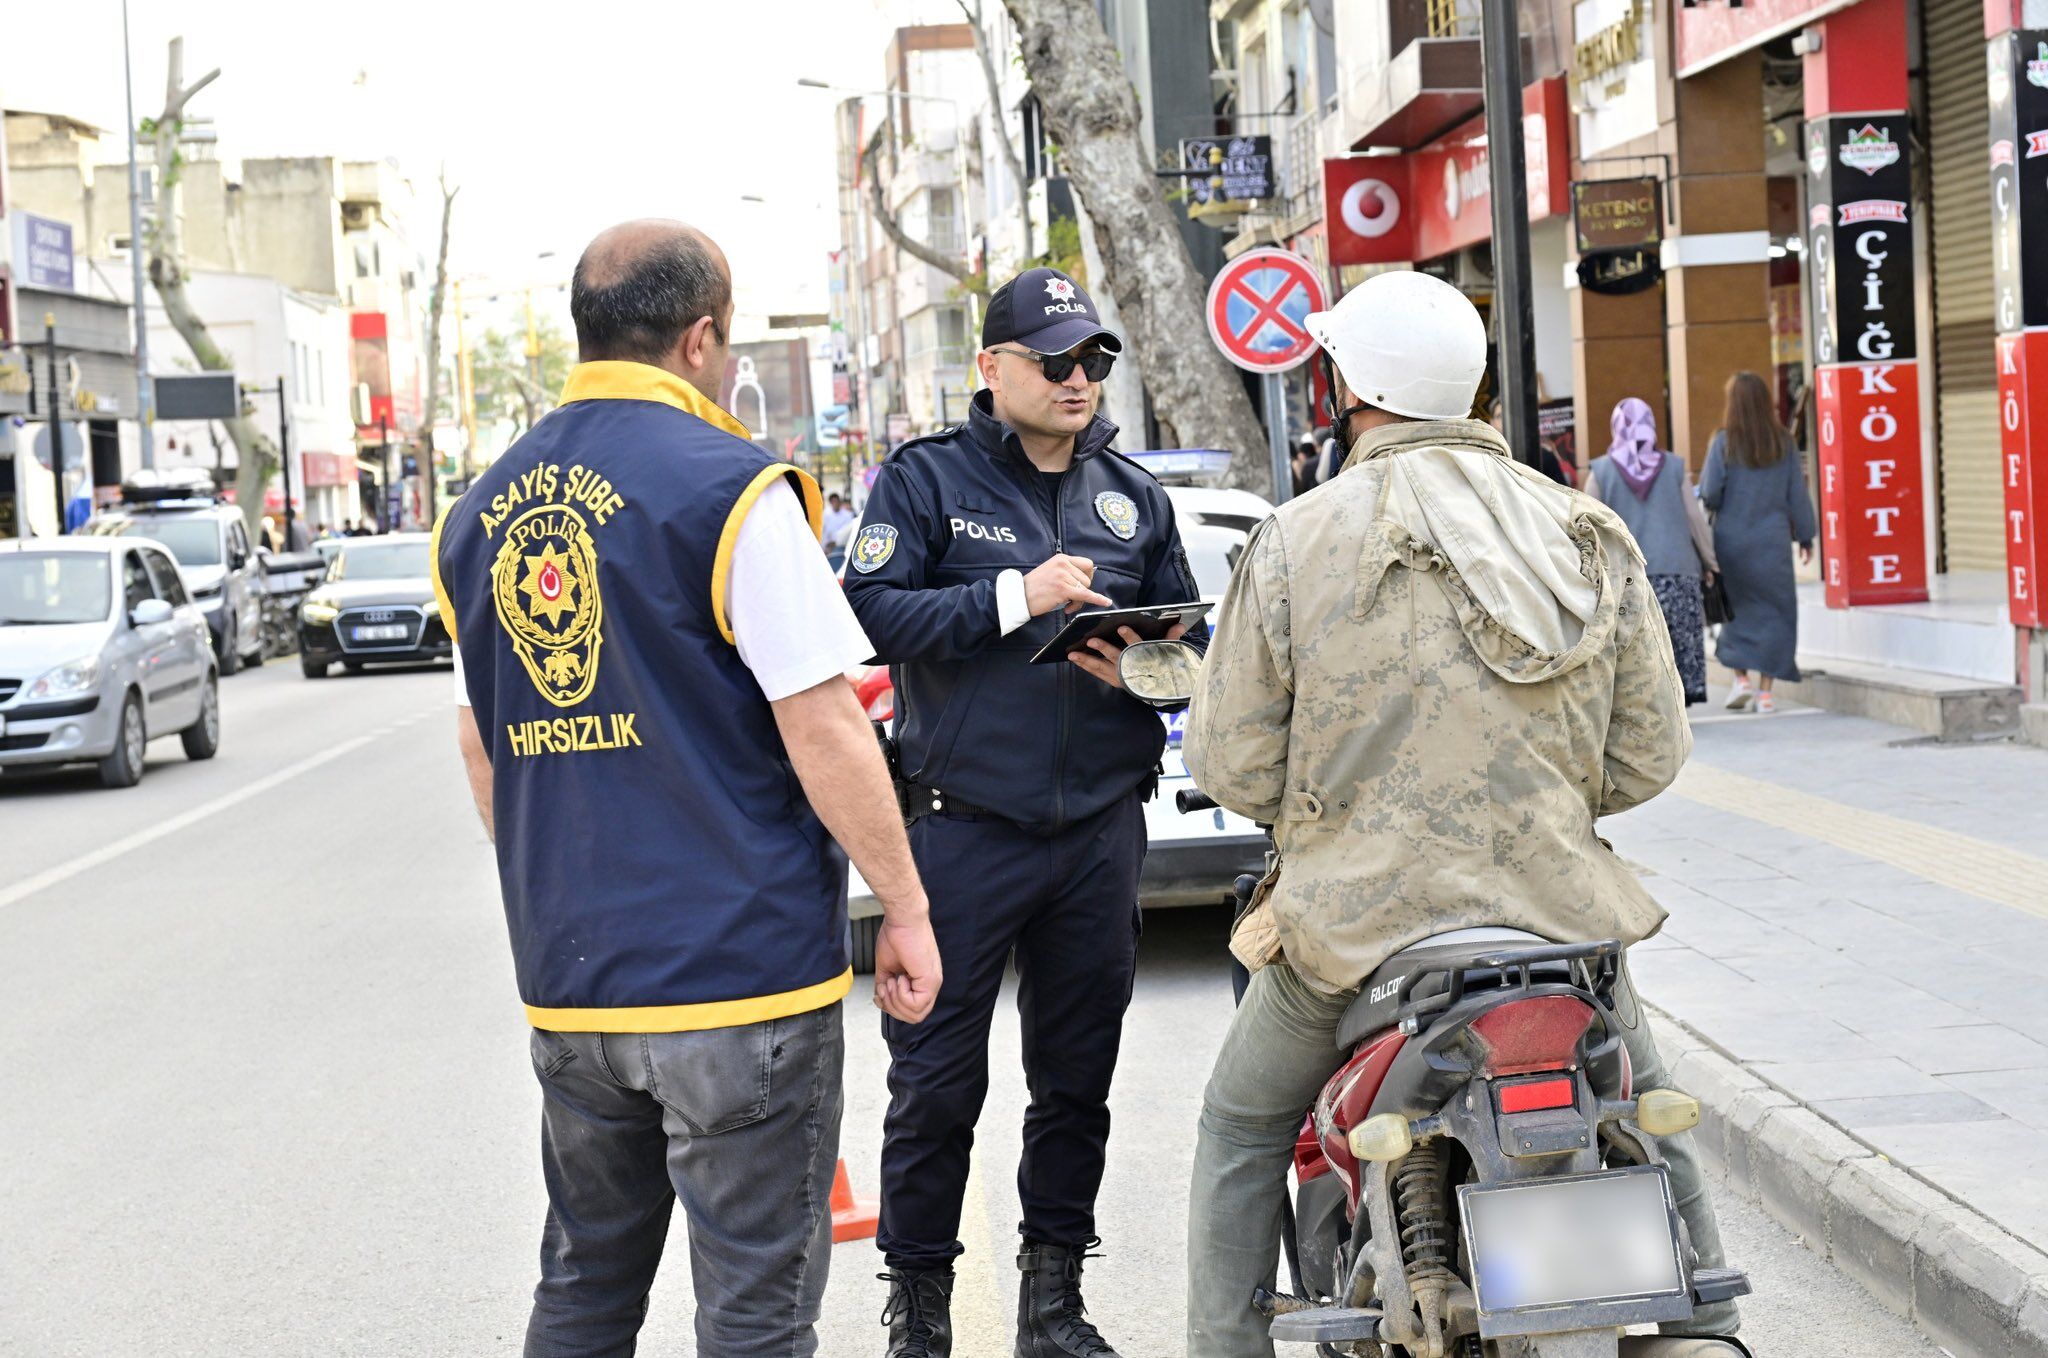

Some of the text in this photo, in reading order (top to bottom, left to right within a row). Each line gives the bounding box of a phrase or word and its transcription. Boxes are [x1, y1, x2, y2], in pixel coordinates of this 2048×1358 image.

[1855, 230, 1903, 584] ÇİĞ KÖFTE
[480, 461, 625, 540] ASAYİŞ ŞUBE
[2003, 341, 2029, 601] KÖFTE
[507, 713, 643, 757] HIRSIZLIK
[1370, 975, 1406, 1004] FALCO
